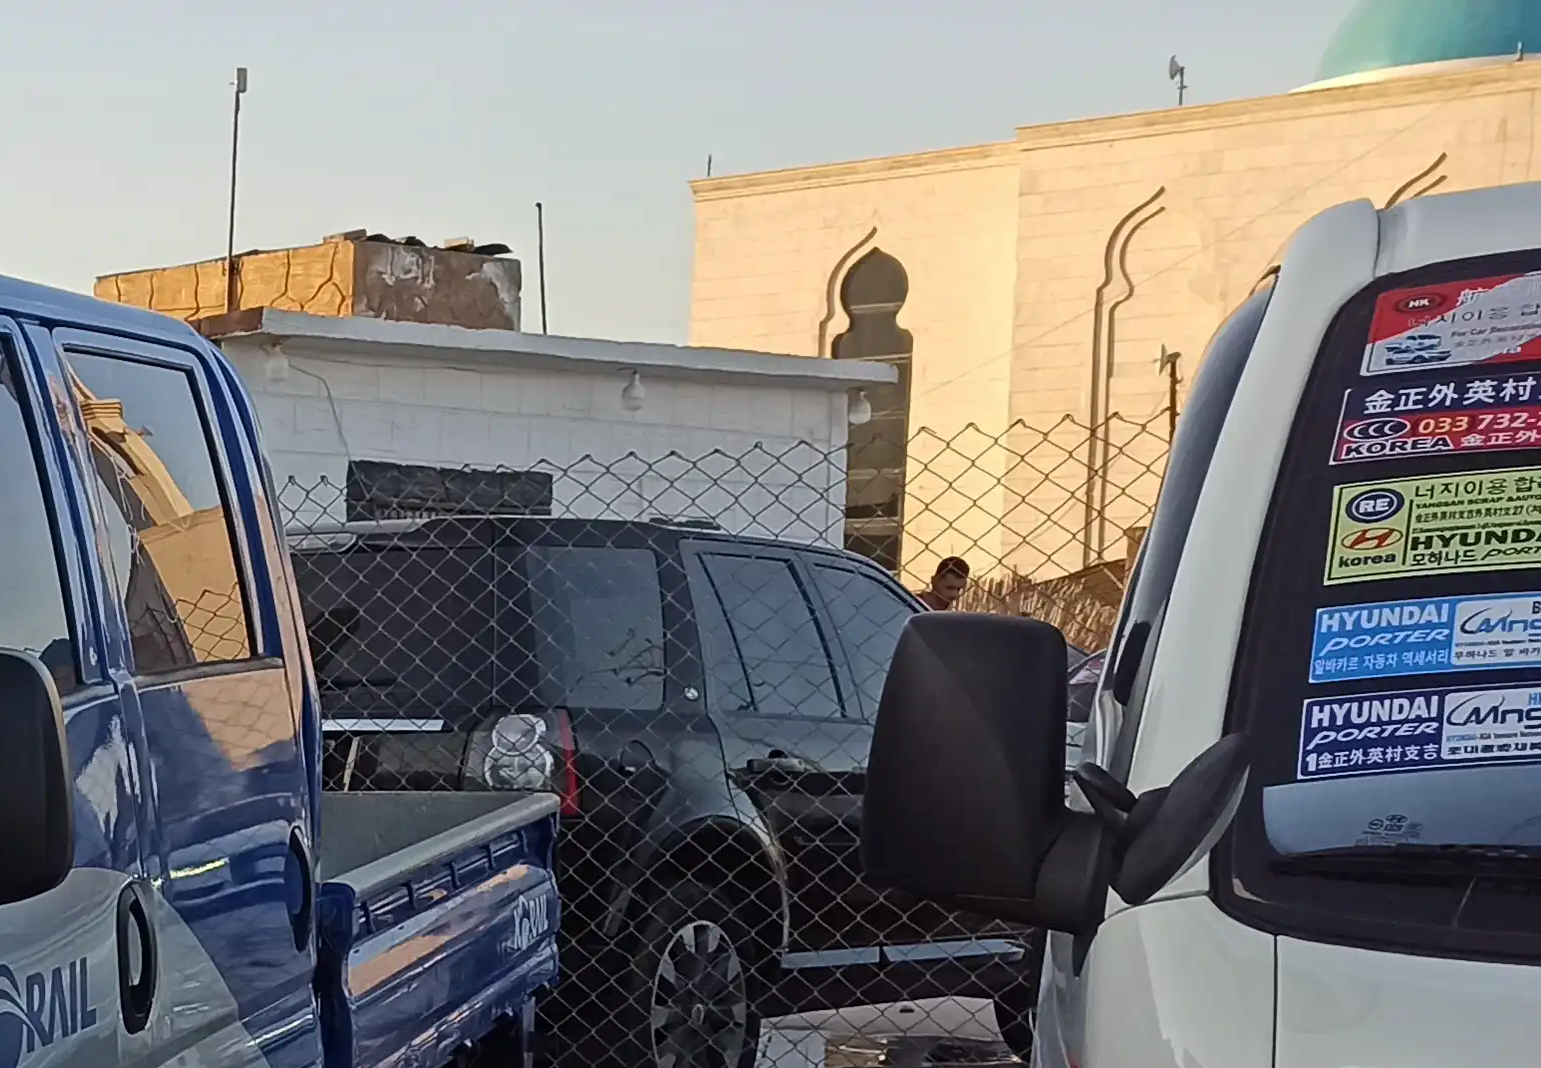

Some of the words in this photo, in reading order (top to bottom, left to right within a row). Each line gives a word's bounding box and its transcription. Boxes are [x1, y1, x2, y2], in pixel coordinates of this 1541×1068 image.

[1364, 376, 1541, 414] 金正外英村
[1418, 416, 1469, 434] 033
[1477, 412, 1541, 430] 732-
[1341, 436, 1454, 459] KOREA
[1414, 476, 1541, 500] 너지이용합
[1359, 498, 1390, 514] RE
[1338, 553, 1396, 568] korea
[1321, 604, 1449, 633] HYUNDAI
[1319, 628, 1451, 656] PORTER
[1311, 695, 1438, 729] HYUNDAI
[1306, 722, 1439, 750] PORTER
